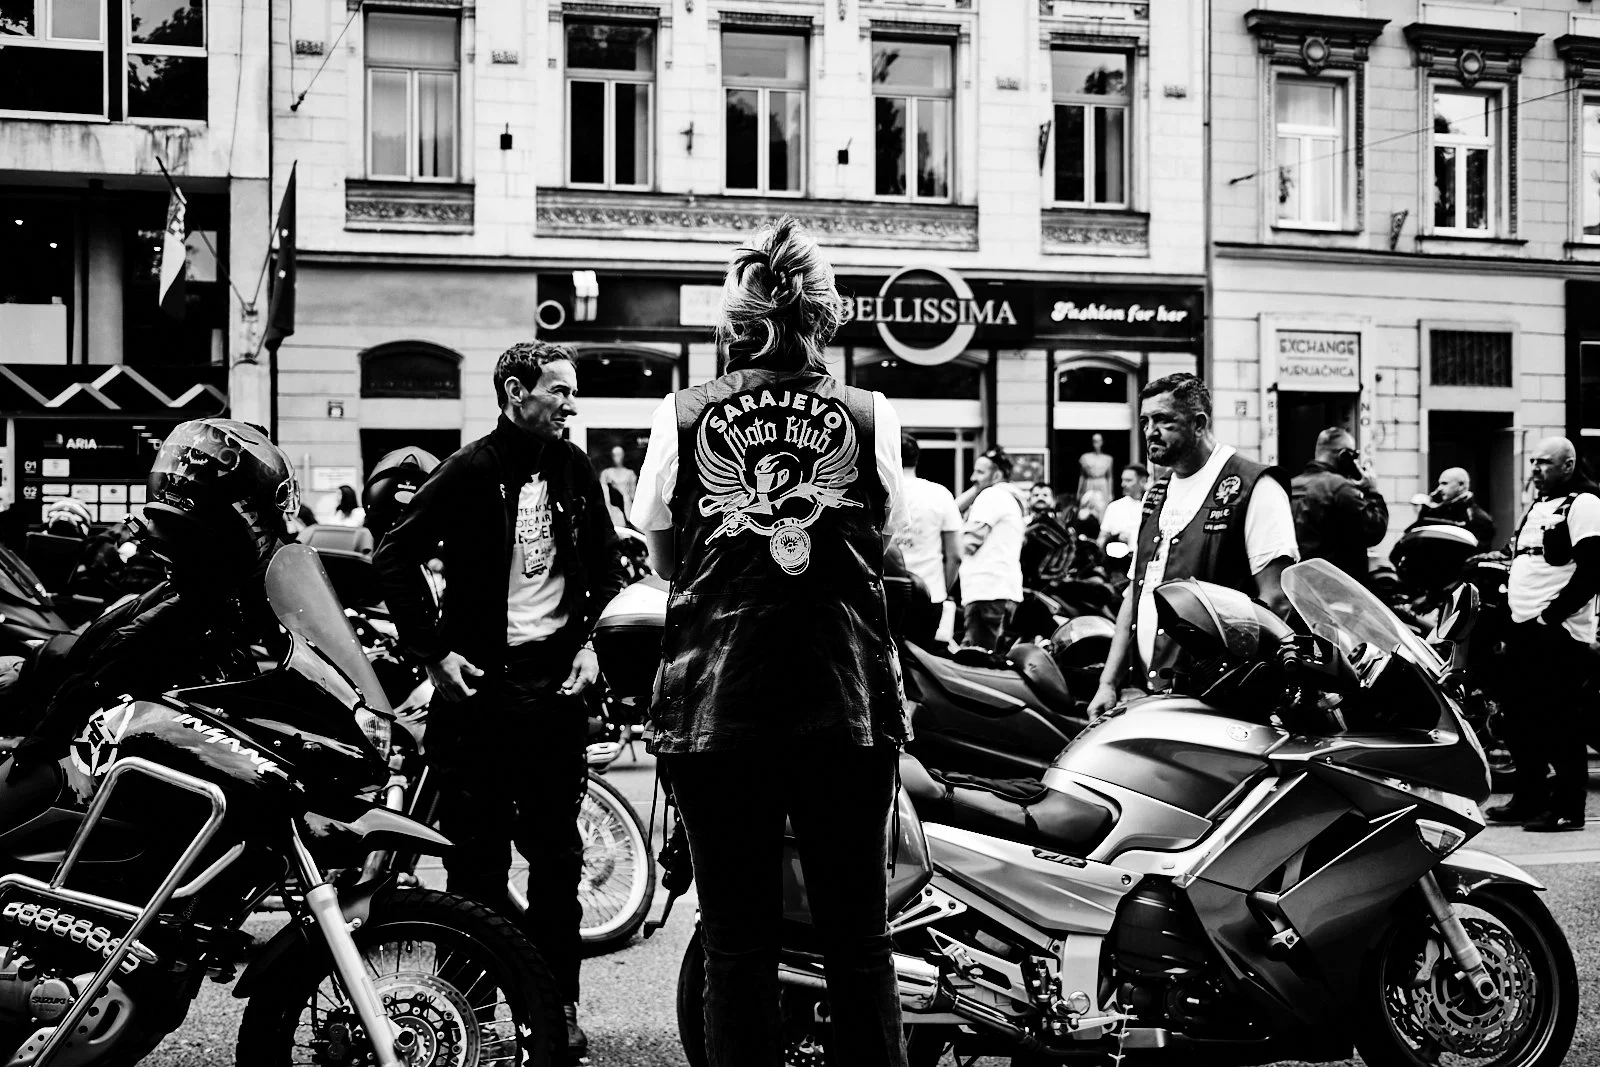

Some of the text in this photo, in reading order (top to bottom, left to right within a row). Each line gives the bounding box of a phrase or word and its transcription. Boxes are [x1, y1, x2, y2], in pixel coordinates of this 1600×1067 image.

[839, 296, 1017, 325] BELLISSIMA
[1051, 301, 1188, 322] Fashion for her
[1279, 338, 1355, 355] EXCHANGE
[709, 389, 843, 433] SARAJEVO
[66, 437, 98, 450] ARIA
[784, 415, 833, 454] Klub
[31, 996, 66, 1004] SUZUKI
